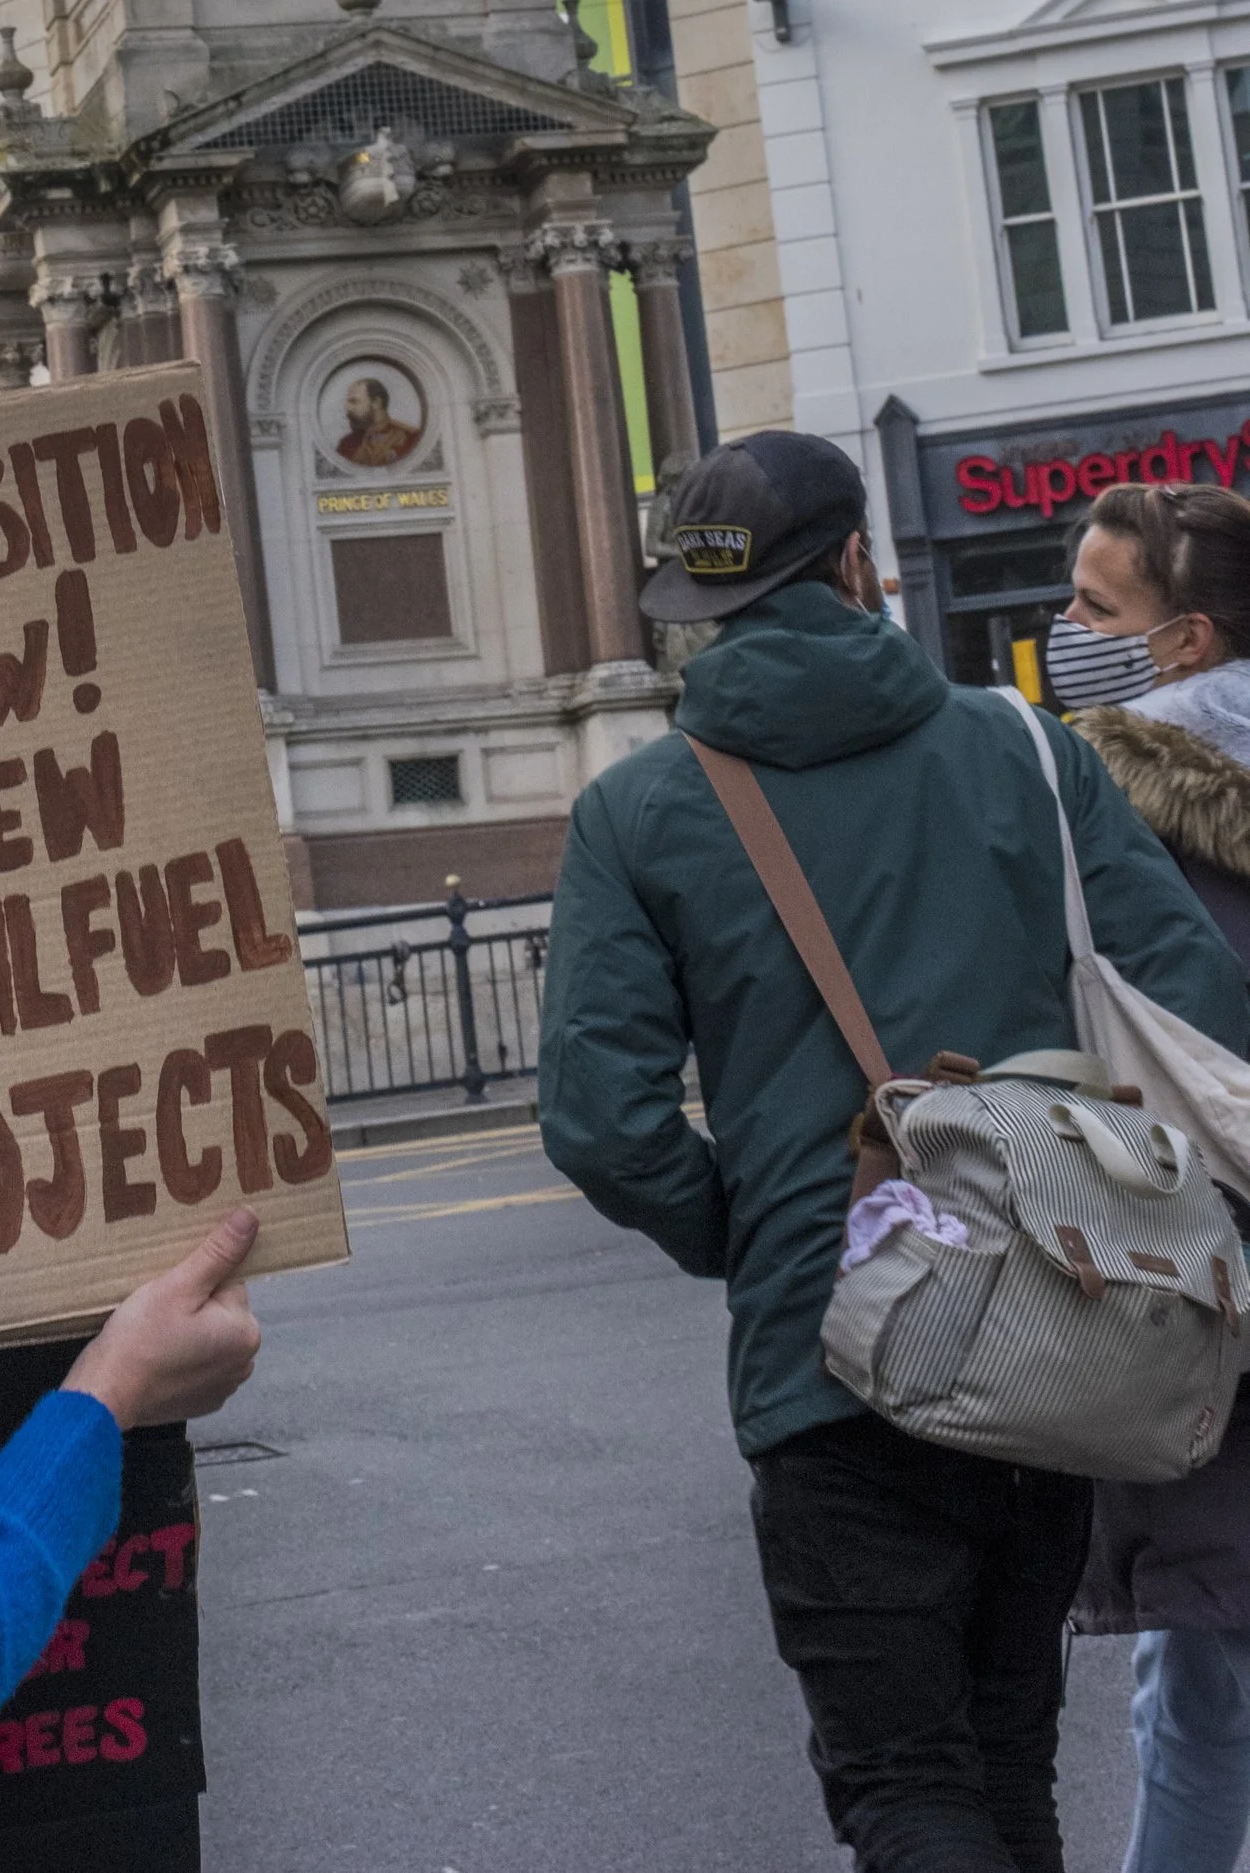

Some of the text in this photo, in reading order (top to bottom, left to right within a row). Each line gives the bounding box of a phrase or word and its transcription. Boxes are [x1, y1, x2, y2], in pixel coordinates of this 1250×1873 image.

[956, 431, 1239, 517] Superdry
[318, 488, 448, 513] PRINCE OF WALES
[678, 530, 746, 552] DARK SEAS
[81, 1524, 197, 1598] ECT
